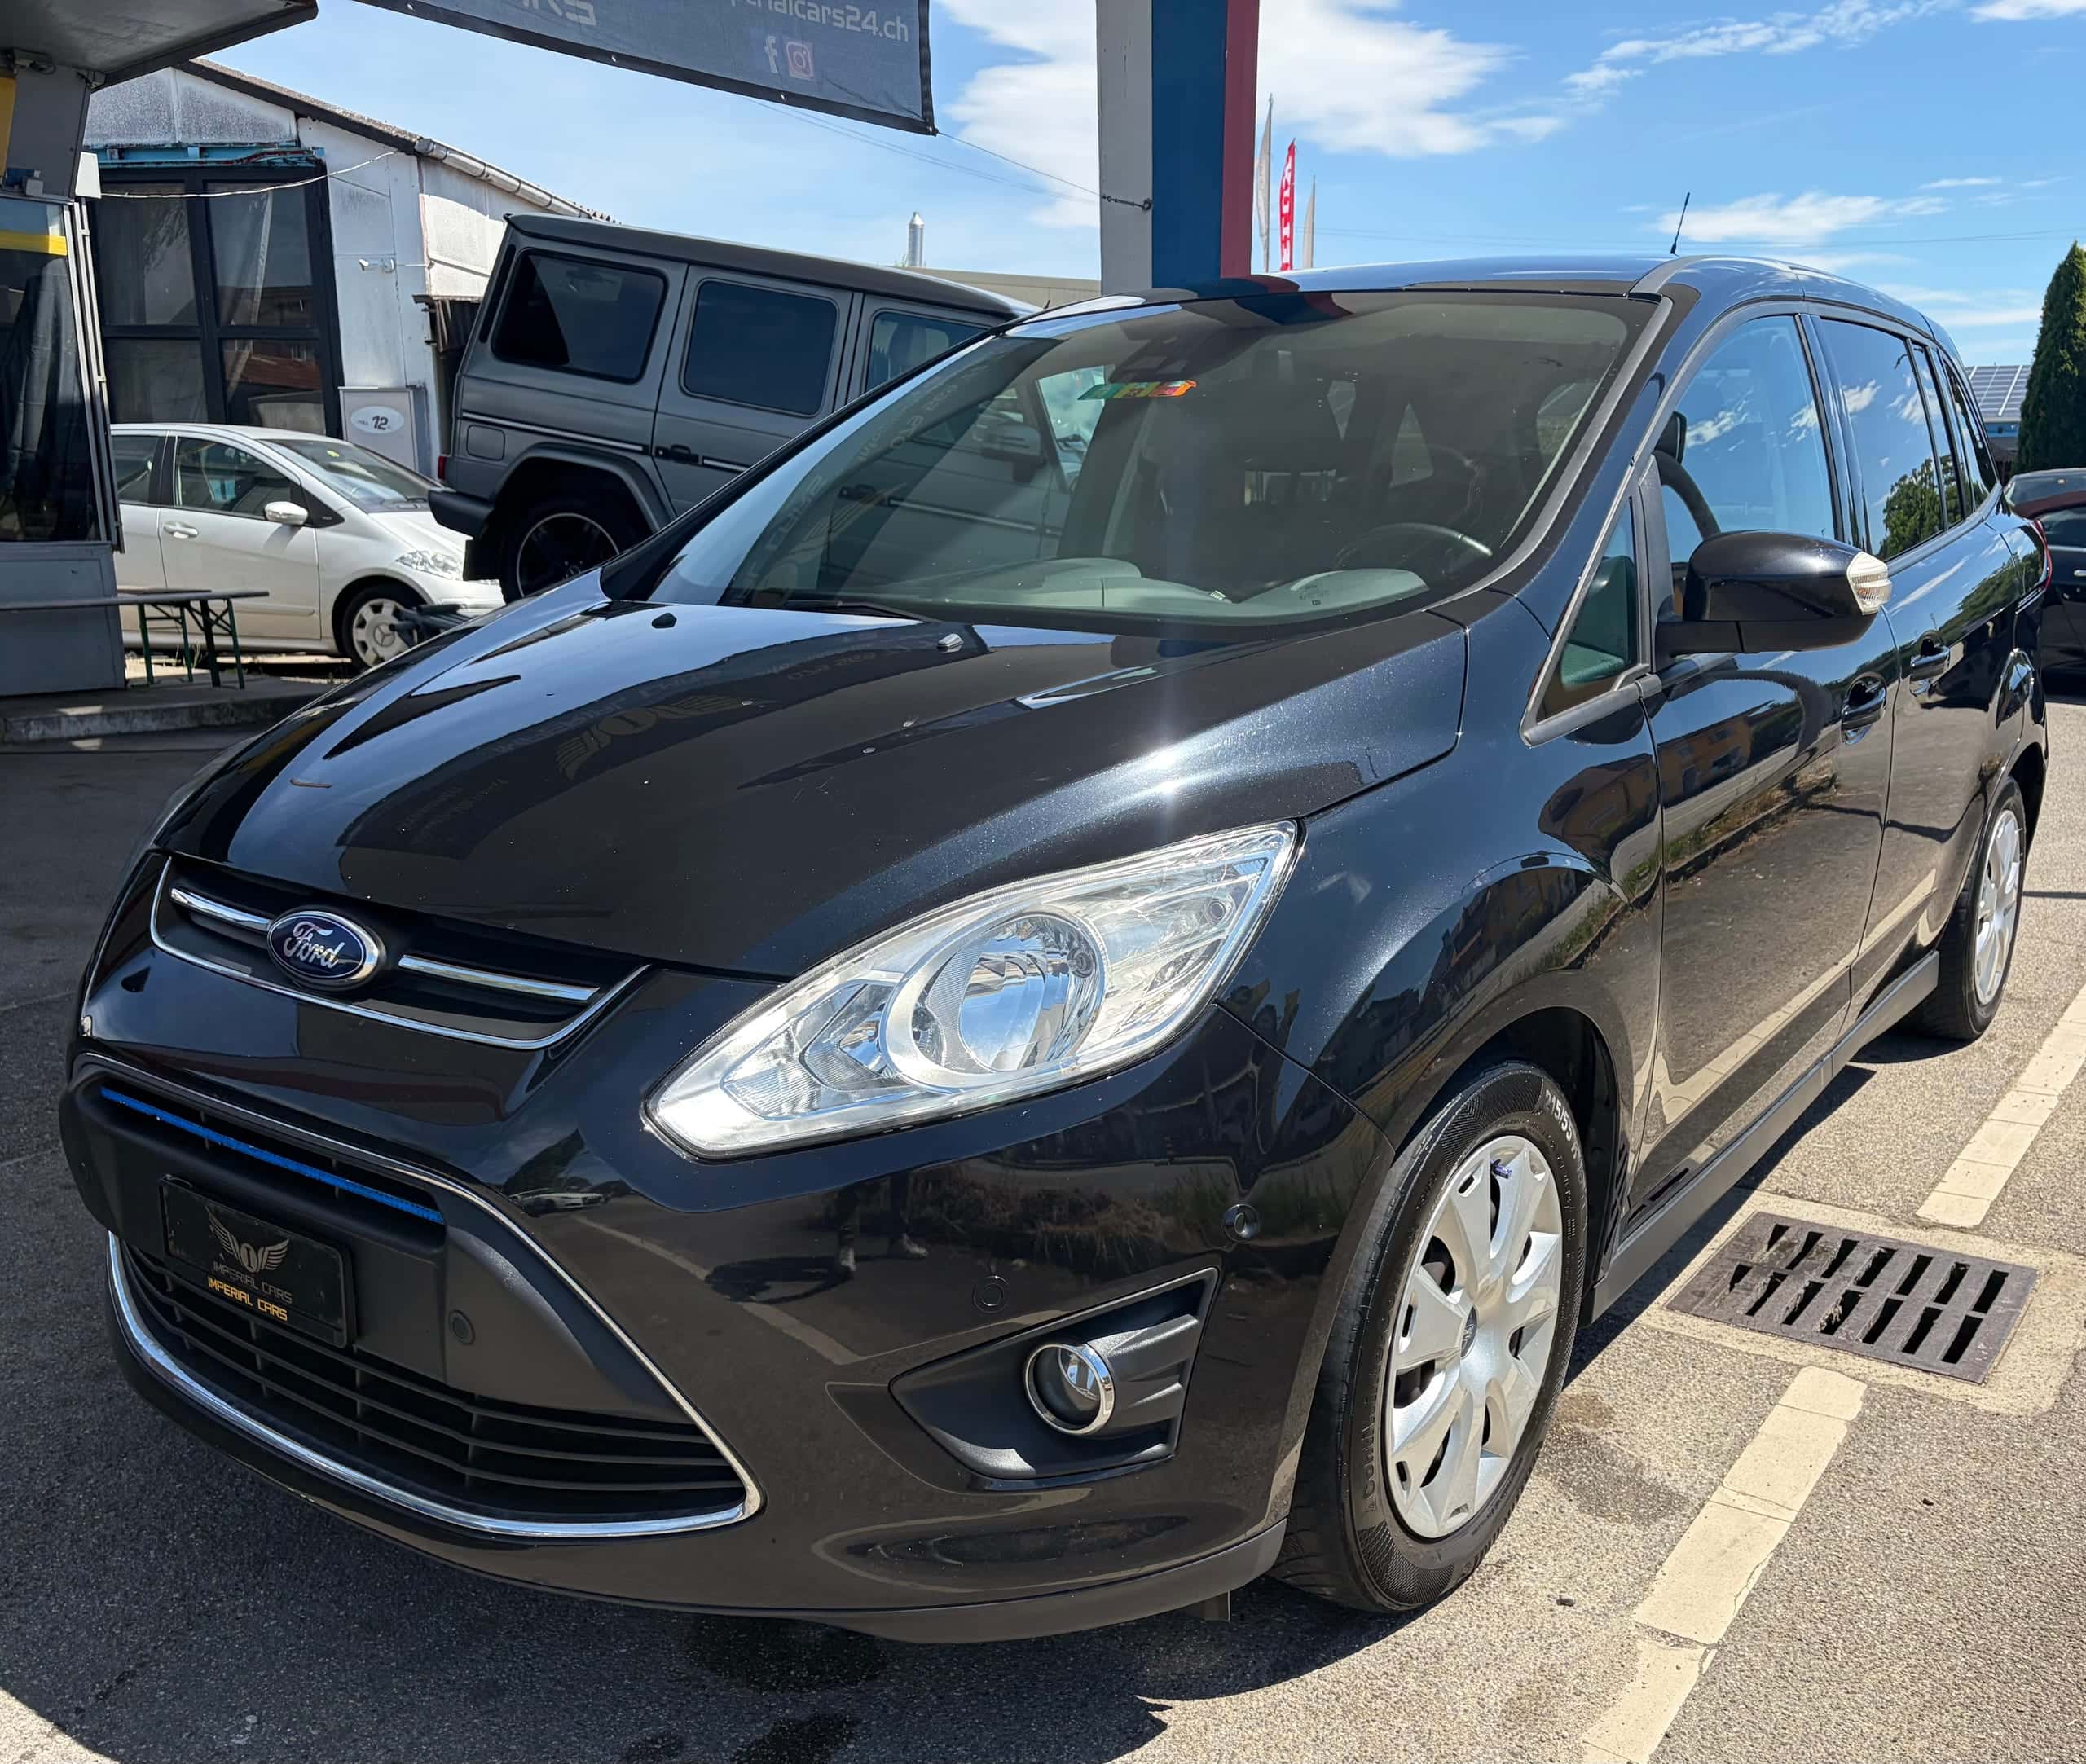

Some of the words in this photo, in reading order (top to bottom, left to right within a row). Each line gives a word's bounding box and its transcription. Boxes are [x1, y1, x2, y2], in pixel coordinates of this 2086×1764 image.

[372, 415, 389, 430] 12
[284, 921, 345, 968] Ford
[208, 1276, 253, 1307] IMPERIAL
[257, 1298, 288, 1322] CARS
[213, 1261, 259, 1291] IMPERIAL
[262, 1281, 293, 1304] CARS
